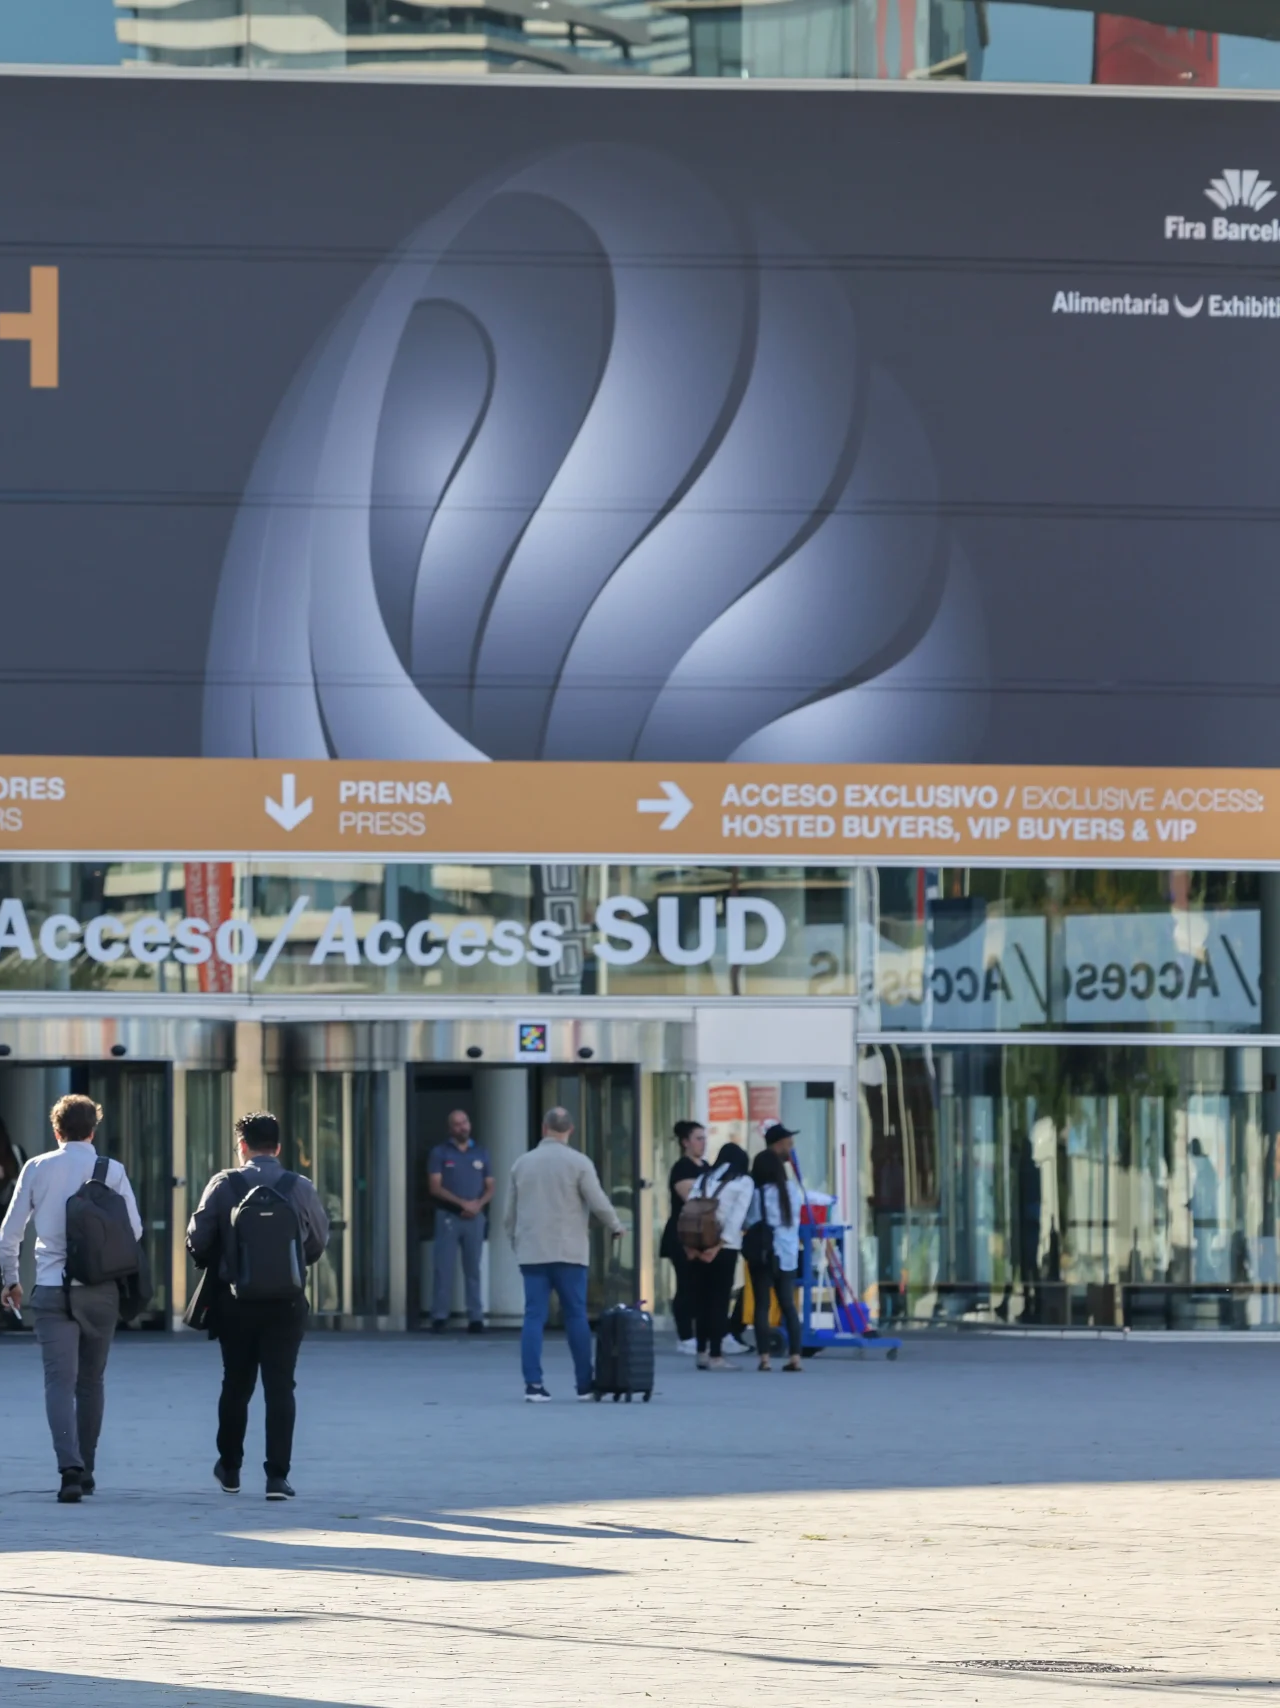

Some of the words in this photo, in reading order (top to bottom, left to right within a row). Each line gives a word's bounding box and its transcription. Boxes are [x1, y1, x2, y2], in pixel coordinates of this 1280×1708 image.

[1164, 215, 1207, 240] Fira
[1051, 290, 1170, 316] Alimentaria
[339, 780, 453, 805] PRENSA
[721, 783, 838, 808] ACCESO
[843, 784, 999, 809] EXCLUSIVO
[1022, 785, 1156, 811] EXCLUSIVE
[1160, 787, 1265, 813] ACCESS:
[339, 810, 426, 836] PRESS
[722, 814, 836, 838] HOSTED
[842, 815, 961, 843] BUYERS,
[966, 816, 1011, 840] VIP
[1017, 817, 1125, 841] BUYERS
[1131, 819, 1150, 842] &
[1155, 819, 1198, 842] VIP
[593, 895, 787, 966] SUD
